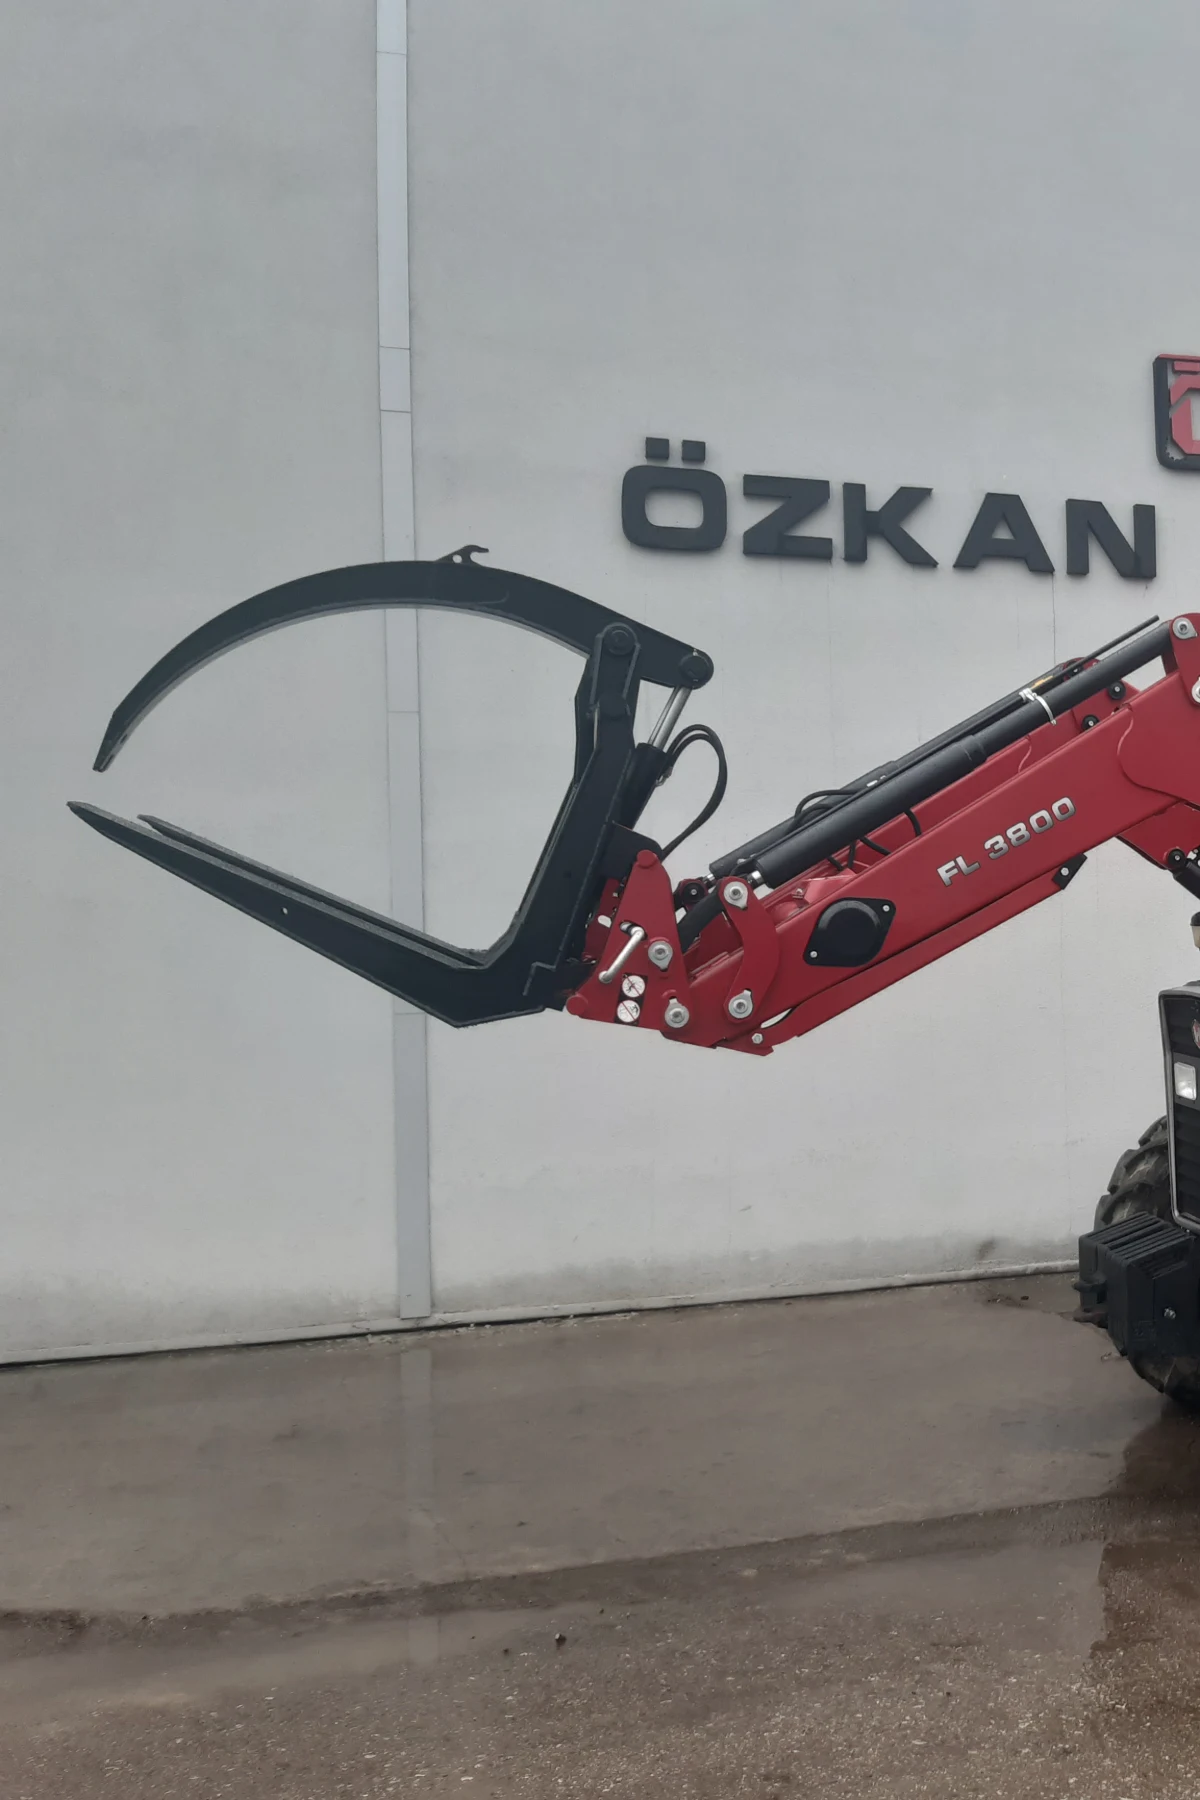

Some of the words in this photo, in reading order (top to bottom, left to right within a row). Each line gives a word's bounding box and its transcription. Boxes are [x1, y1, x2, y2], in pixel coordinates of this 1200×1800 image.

[622, 437, 1157, 579] ÖZKAN
[936, 855, 981, 887] FL
[984, 796, 1076, 860] 3800
